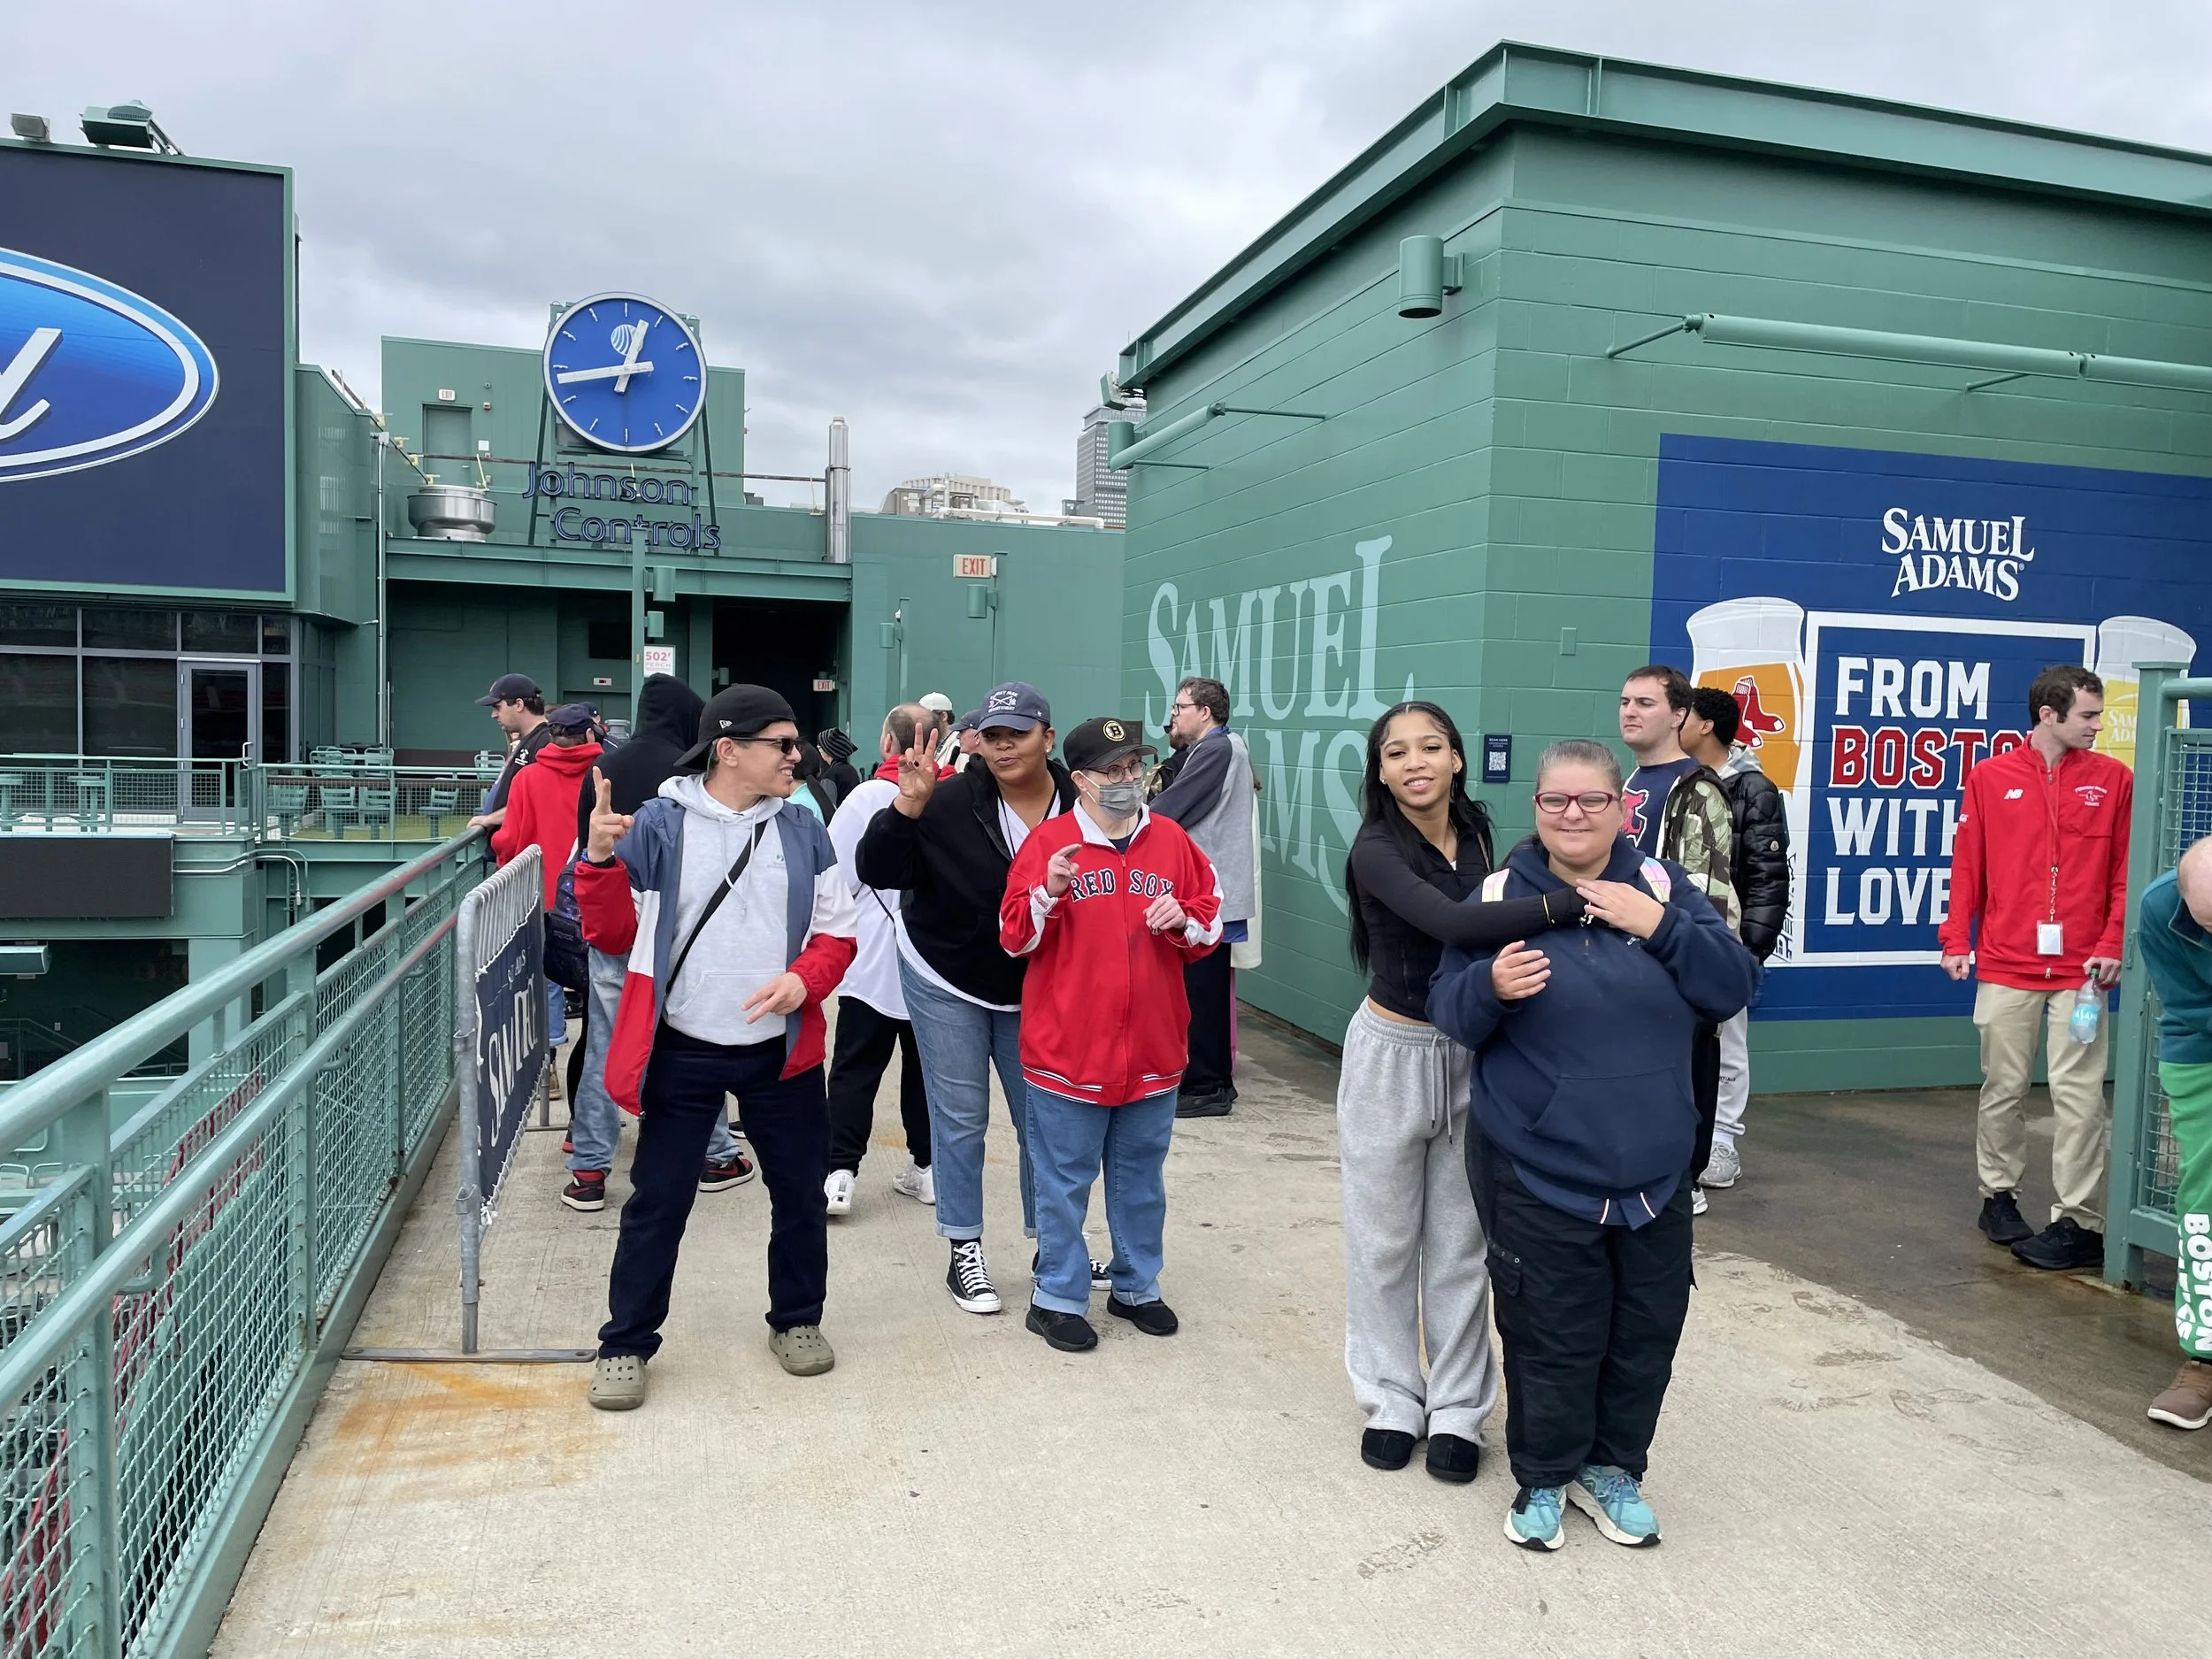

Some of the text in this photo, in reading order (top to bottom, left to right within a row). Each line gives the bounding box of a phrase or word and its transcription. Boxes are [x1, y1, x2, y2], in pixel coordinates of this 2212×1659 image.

[523, 461, 688, 504] Johnson
[553, 507, 721, 549] Controls
[1882, 507, 2035, 562] SAMUEL
[962, 557, 986, 576] EXIT
[1144, 534, 1414, 740] SAMUEL
[818, 680, 830, 690] EXIT
[1834, 656, 1991, 720] FROM
[2108, 709, 2138, 729] SAM
[1827, 725, 2028, 791] BOST
[1071, 868, 1116, 902] RED
[1129, 869, 1174, 899] SOX
[1824, 867, 1952, 926] LOVE
[2184, 1213, 2212, 1351] BOSTON
